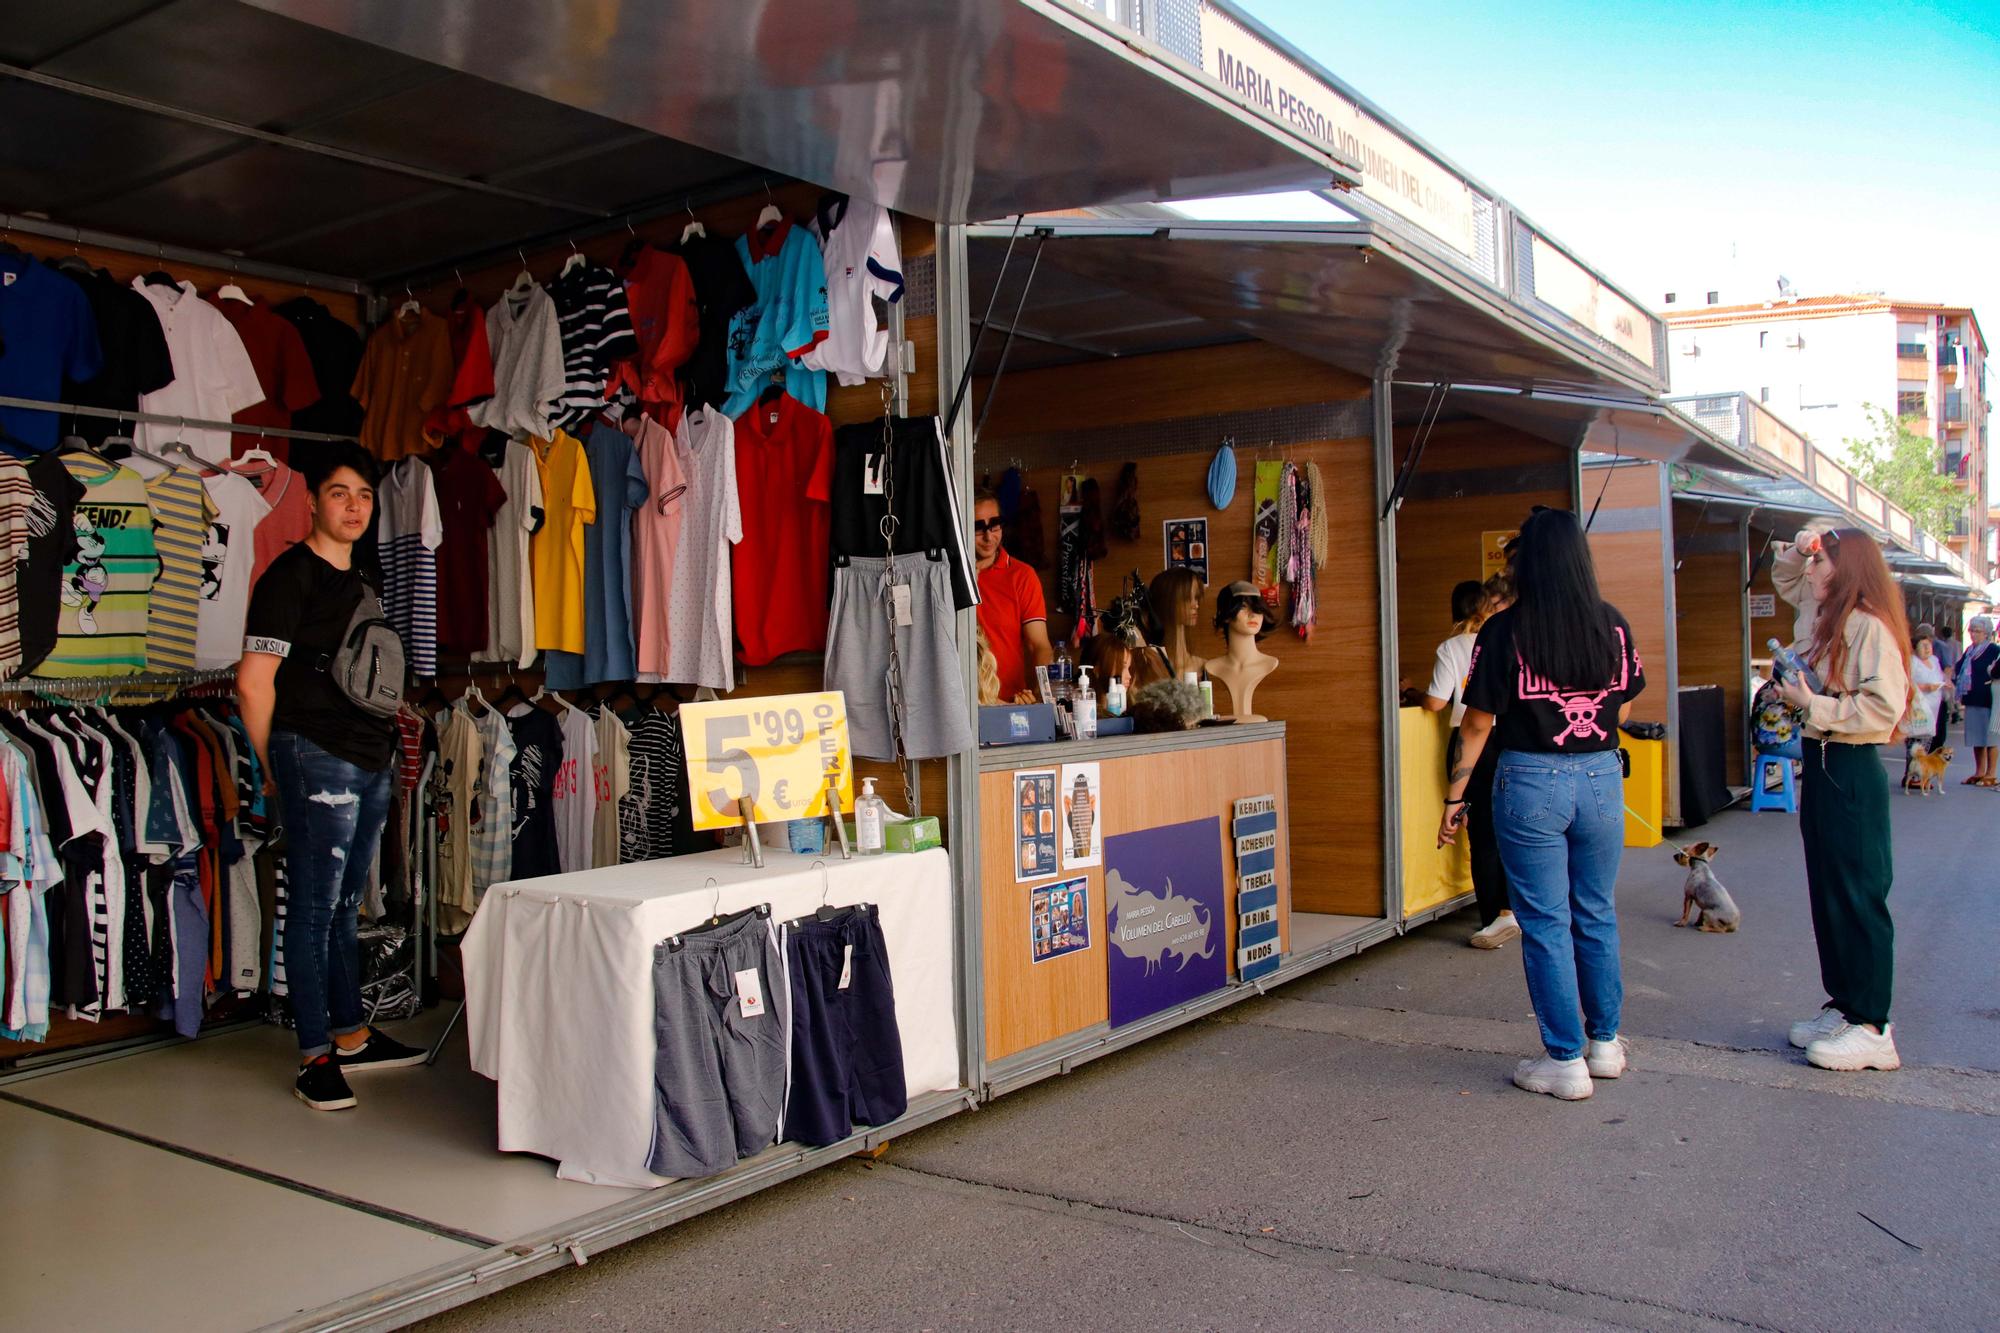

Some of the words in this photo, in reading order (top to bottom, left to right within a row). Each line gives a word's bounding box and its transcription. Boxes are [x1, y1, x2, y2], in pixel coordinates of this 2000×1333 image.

[1218, 48, 1274, 113] MARIA
[1279, 87, 1335, 146] PESSOA
[1338, 127, 1398, 192] VOLUMEN
[1401, 170, 1423, 208] DEL
[255, 639, 287, 656] SIKSILK
[1239, 799, 1275, 816] KERATINA
[1245, 872, 1272, 891] TRENZA
[1120, 923, 1153, 942] VOLUMEN
[1153, 919, 1165, 934] DEL
[1165, 911, 1192, 929] CABELLO
[1247, 943, 1272, 962] NUDOS
